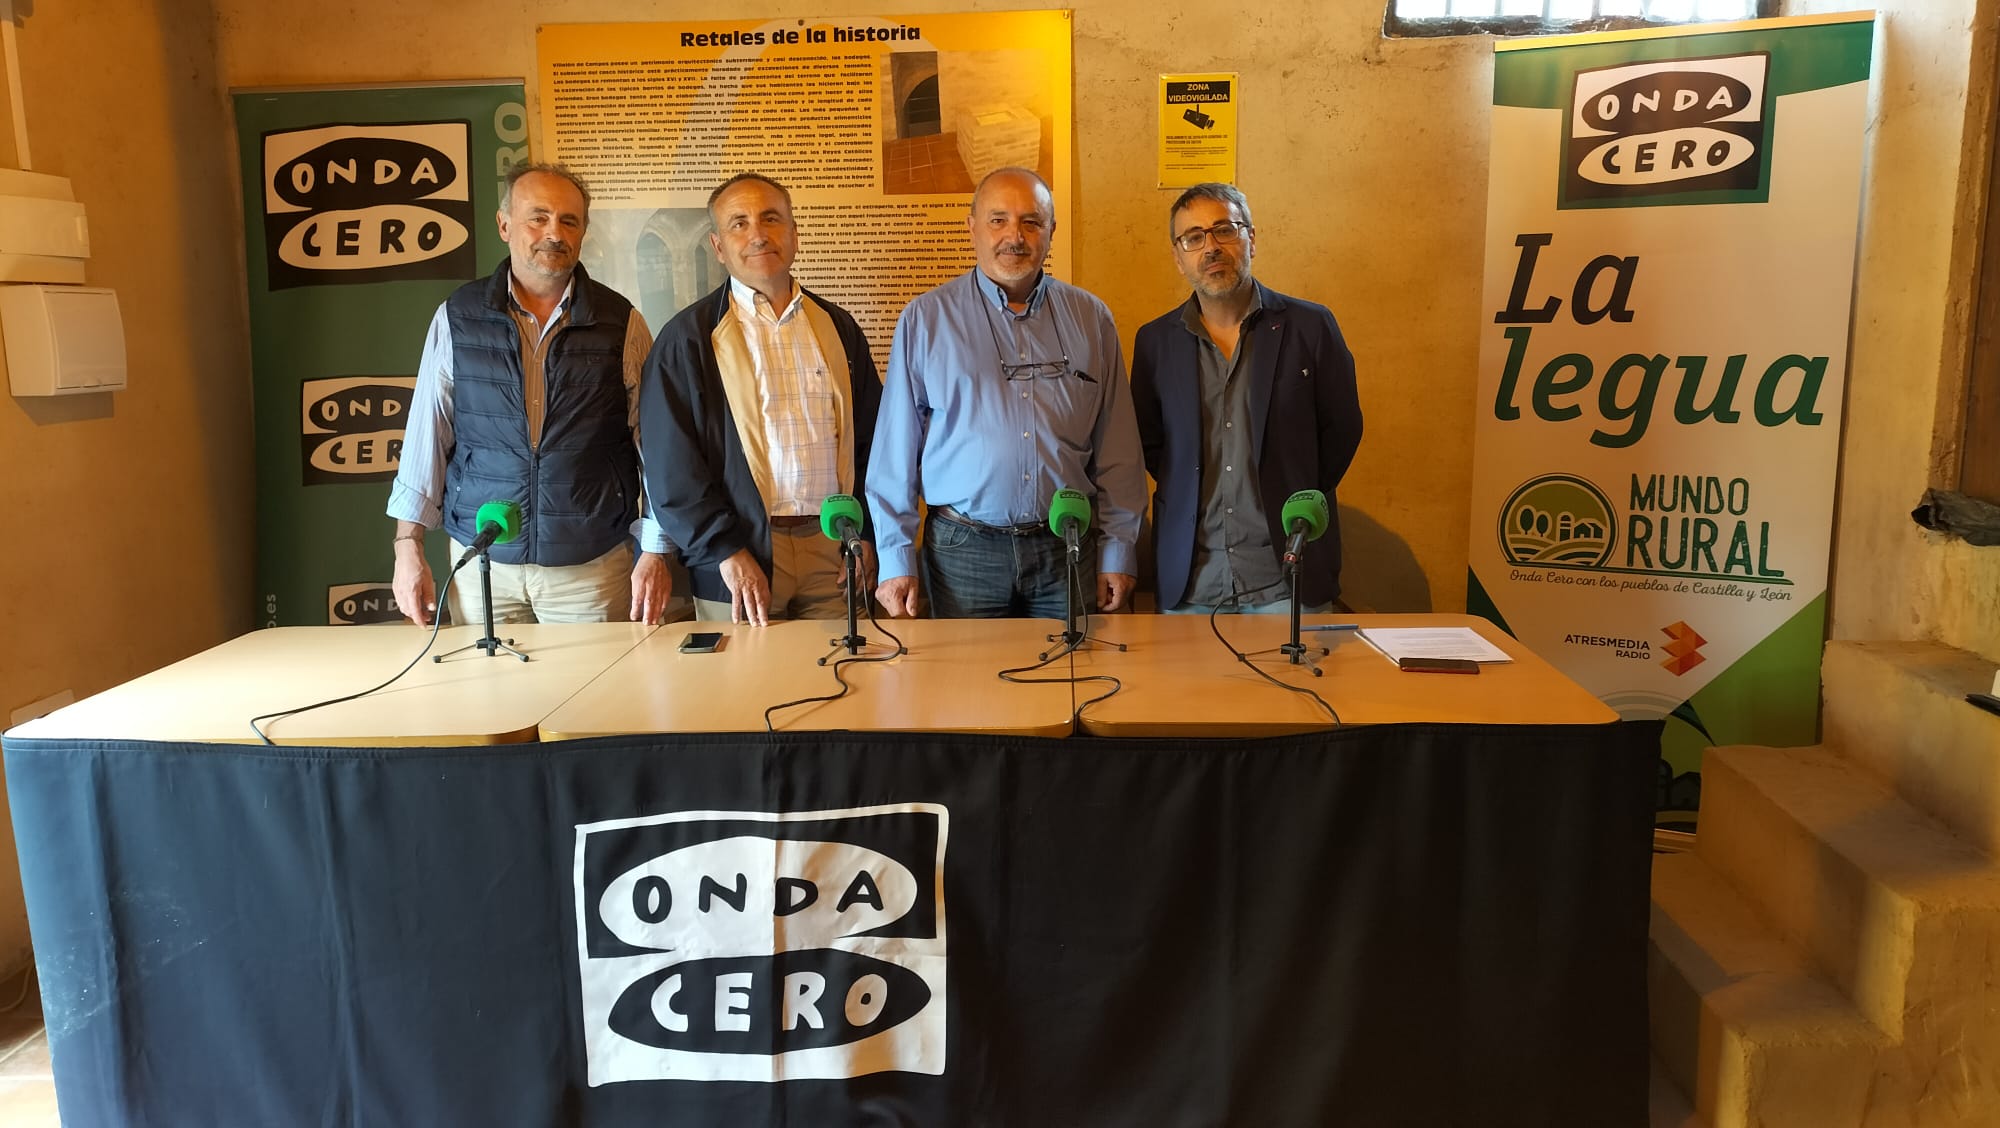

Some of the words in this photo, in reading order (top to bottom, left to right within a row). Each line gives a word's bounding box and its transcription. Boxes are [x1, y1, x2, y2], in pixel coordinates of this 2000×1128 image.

[680, 30, 765, 47] Retales
[772, 29, 799, 44] de
[806, 28, 826, 43] la
[833, 25, 921, 42] historia
[1168, 94, 1228, 102] VIDEOVIGILADA
[1597, 86, 1734, 121] ONDA
[291, 155, 439, 194] ONDA
[1601, 139, 1731, 175] CERO
[301, 217, 443, 258] CERO
[1494, 233, 1640, 326] La
[1494, 326, 1830, 449] legua
[321, 398, 403, 421] OND
[329, 438, 404, 465] CER
[1629, 473, 1750, 516] MUNDO
[1626, 516, 1784, 577] RURAL
[1510, 570, 1543, 582] Onda
[1546, 572, 1574, 584] Cero
[1575, 577, 1597, 586] con
[1599, 575, 1618, 588] los
[1620, 578, 1670, 592] pueblos
[1672, 580, 1690, 593] de
[1692, 579, 1744, 598] Castilla
[1746, 590, 1756, 601] y
[1760, 587, 1792, 600] León
[343, 599, 401, 615] OND
[1564, 634, 1650, 651] ATRESMEDIA
[1615, 650, 1651, 660] RADIO
[632, 870, 884, 924] ONDA
[650, 971, 888, 1033] CERO
